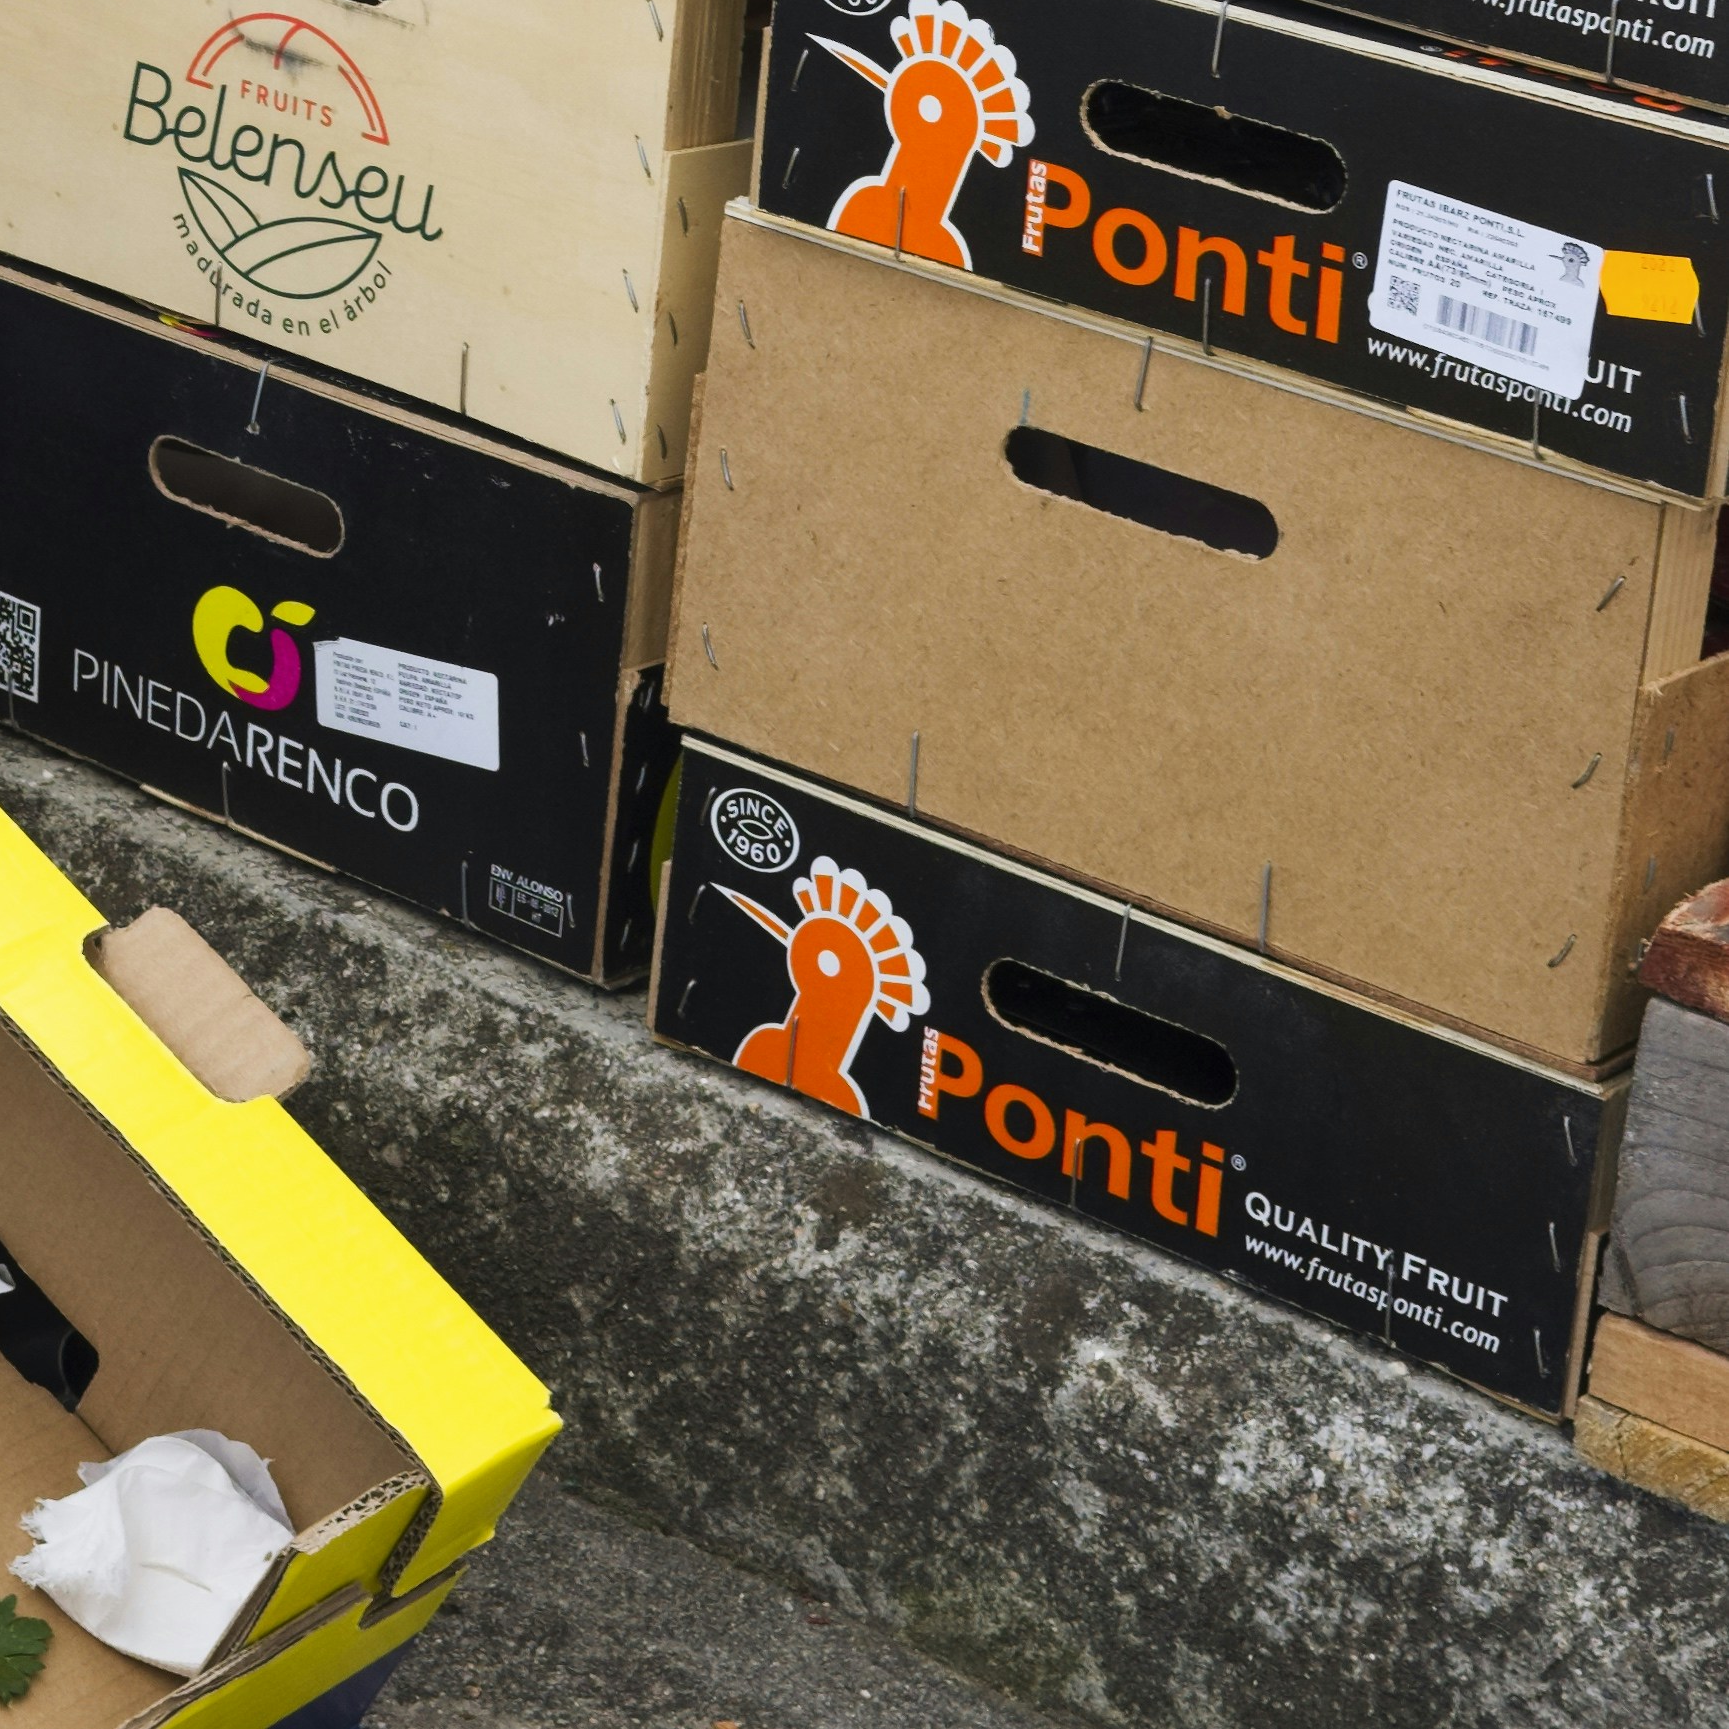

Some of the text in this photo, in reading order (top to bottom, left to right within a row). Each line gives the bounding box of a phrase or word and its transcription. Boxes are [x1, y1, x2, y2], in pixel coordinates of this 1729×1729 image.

[125, 61, 443, 241] Belenseu
[239, 78, 336, 129] FRUITS
[1022, 158, 1048, 256] Frutas
[1038, 160, 1345, 344] Ponti
[1397, 189, 1436, 209] FRUTAS
[281, 257, 392, 338] en el árbol
[73, 647, 420, 834] PINEDARENCO
[724, 795, 791, 841] SINCE
[724, 831, 783, 867] 1960
[932, 1031, 1227, 1238] Ponti
[1244, 1230, 1500, 1355] www.frutasponti.com
[1245, 1191, 1509, 1321] QUALITY FRUIT
